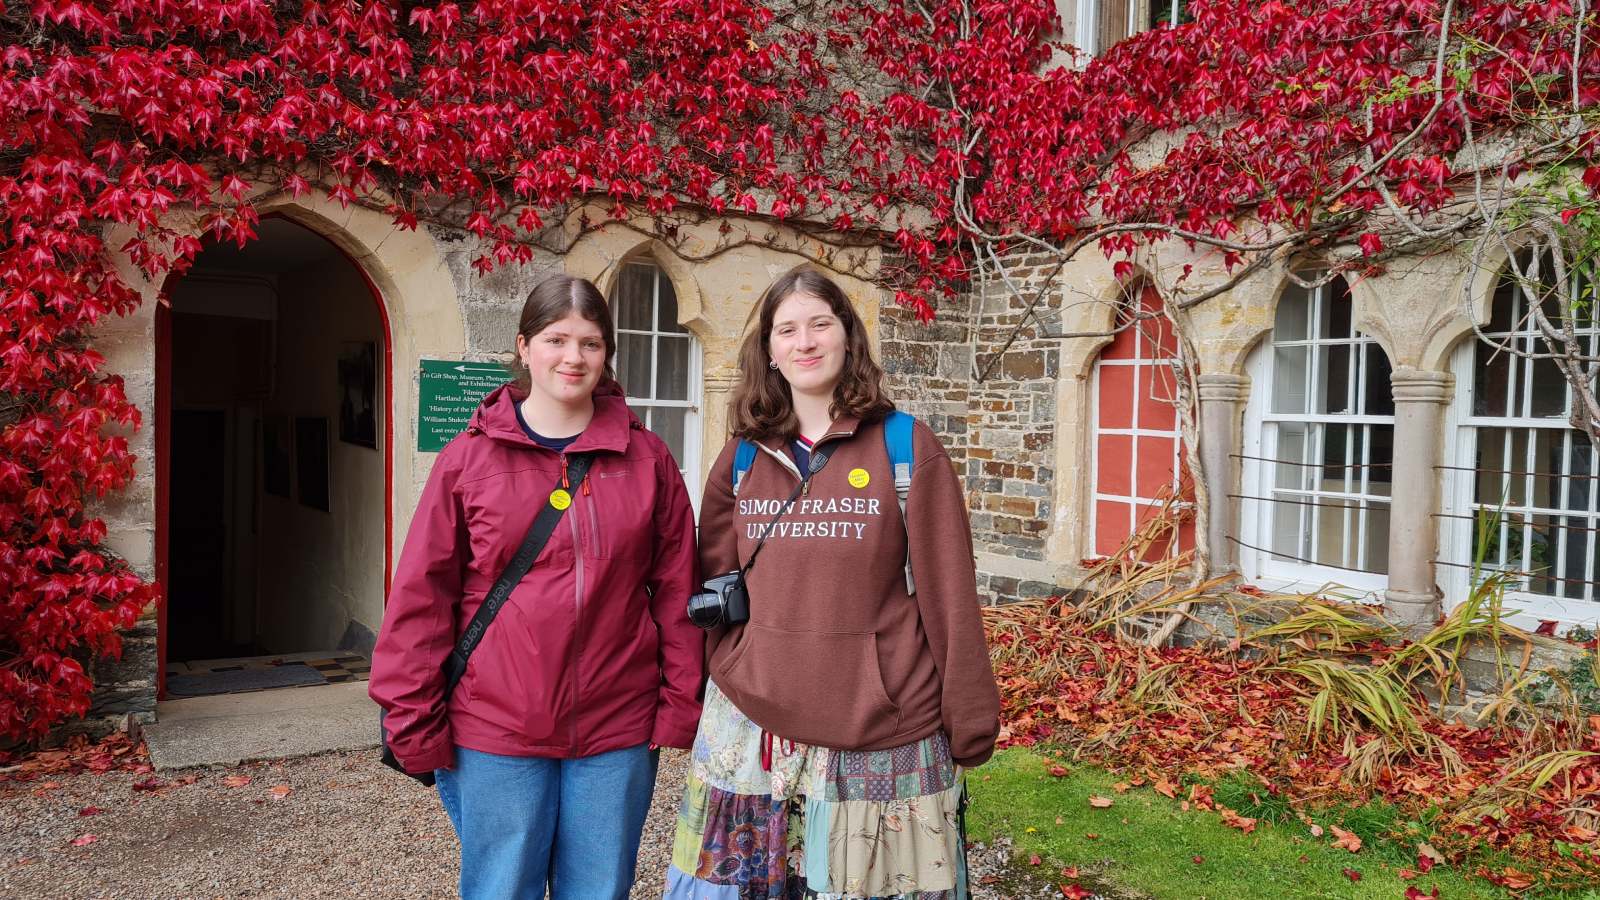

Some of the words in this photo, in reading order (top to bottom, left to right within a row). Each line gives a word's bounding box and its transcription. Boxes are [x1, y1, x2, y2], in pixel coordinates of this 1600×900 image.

[738, 498, 796, 515] SIMON
[799, 497, 881, 515] FRASER
[746, 521, 867, 539] UNIVERSITY
